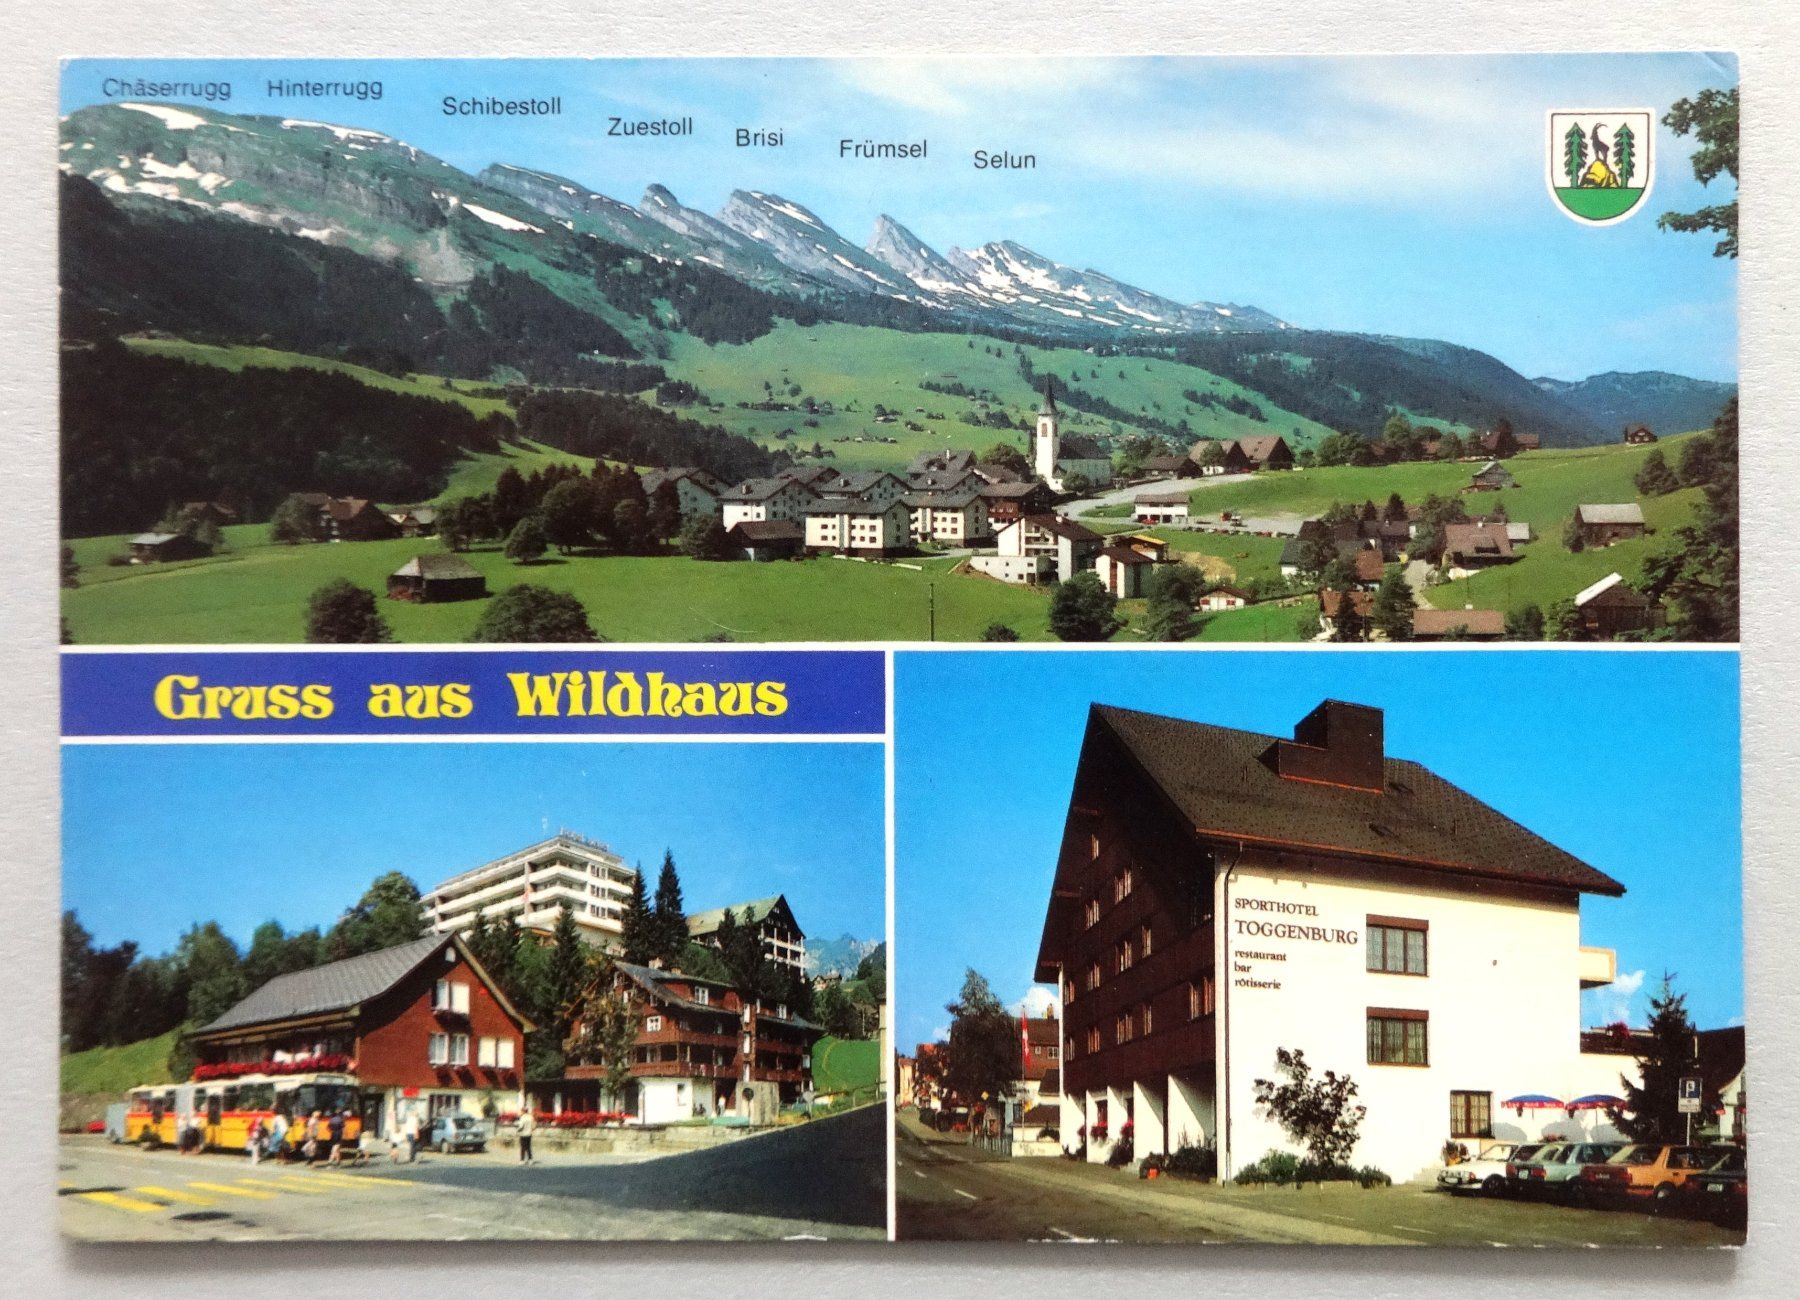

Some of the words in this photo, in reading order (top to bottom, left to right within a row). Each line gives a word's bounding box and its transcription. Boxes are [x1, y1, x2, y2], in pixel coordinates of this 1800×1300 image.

[101, 77, 232, 101] Chäserrugg
[267, 79, 383, 100] Hinterrugg
[442, 96, 562, 116] Schibestoll
[607, 116, 693, 137] Zuestoll
[736, 128, 784, 147] Brisi
[840, 139, 927, 158] Frümsel
[973, 150, 1036, 169] Selun
[154, 674, 335, 720] Gruss
[367, 682, 474, 720] aus
[506, 670, 789, 718] Wildhaus
[1234, 897, 1318, 916] SPORTHOTEL
[1234, 919, 1358, 945] TOGGENBURG
[1234, 949, 1287, 962] restaurant
[1234, 960, 1252, 973] bar
